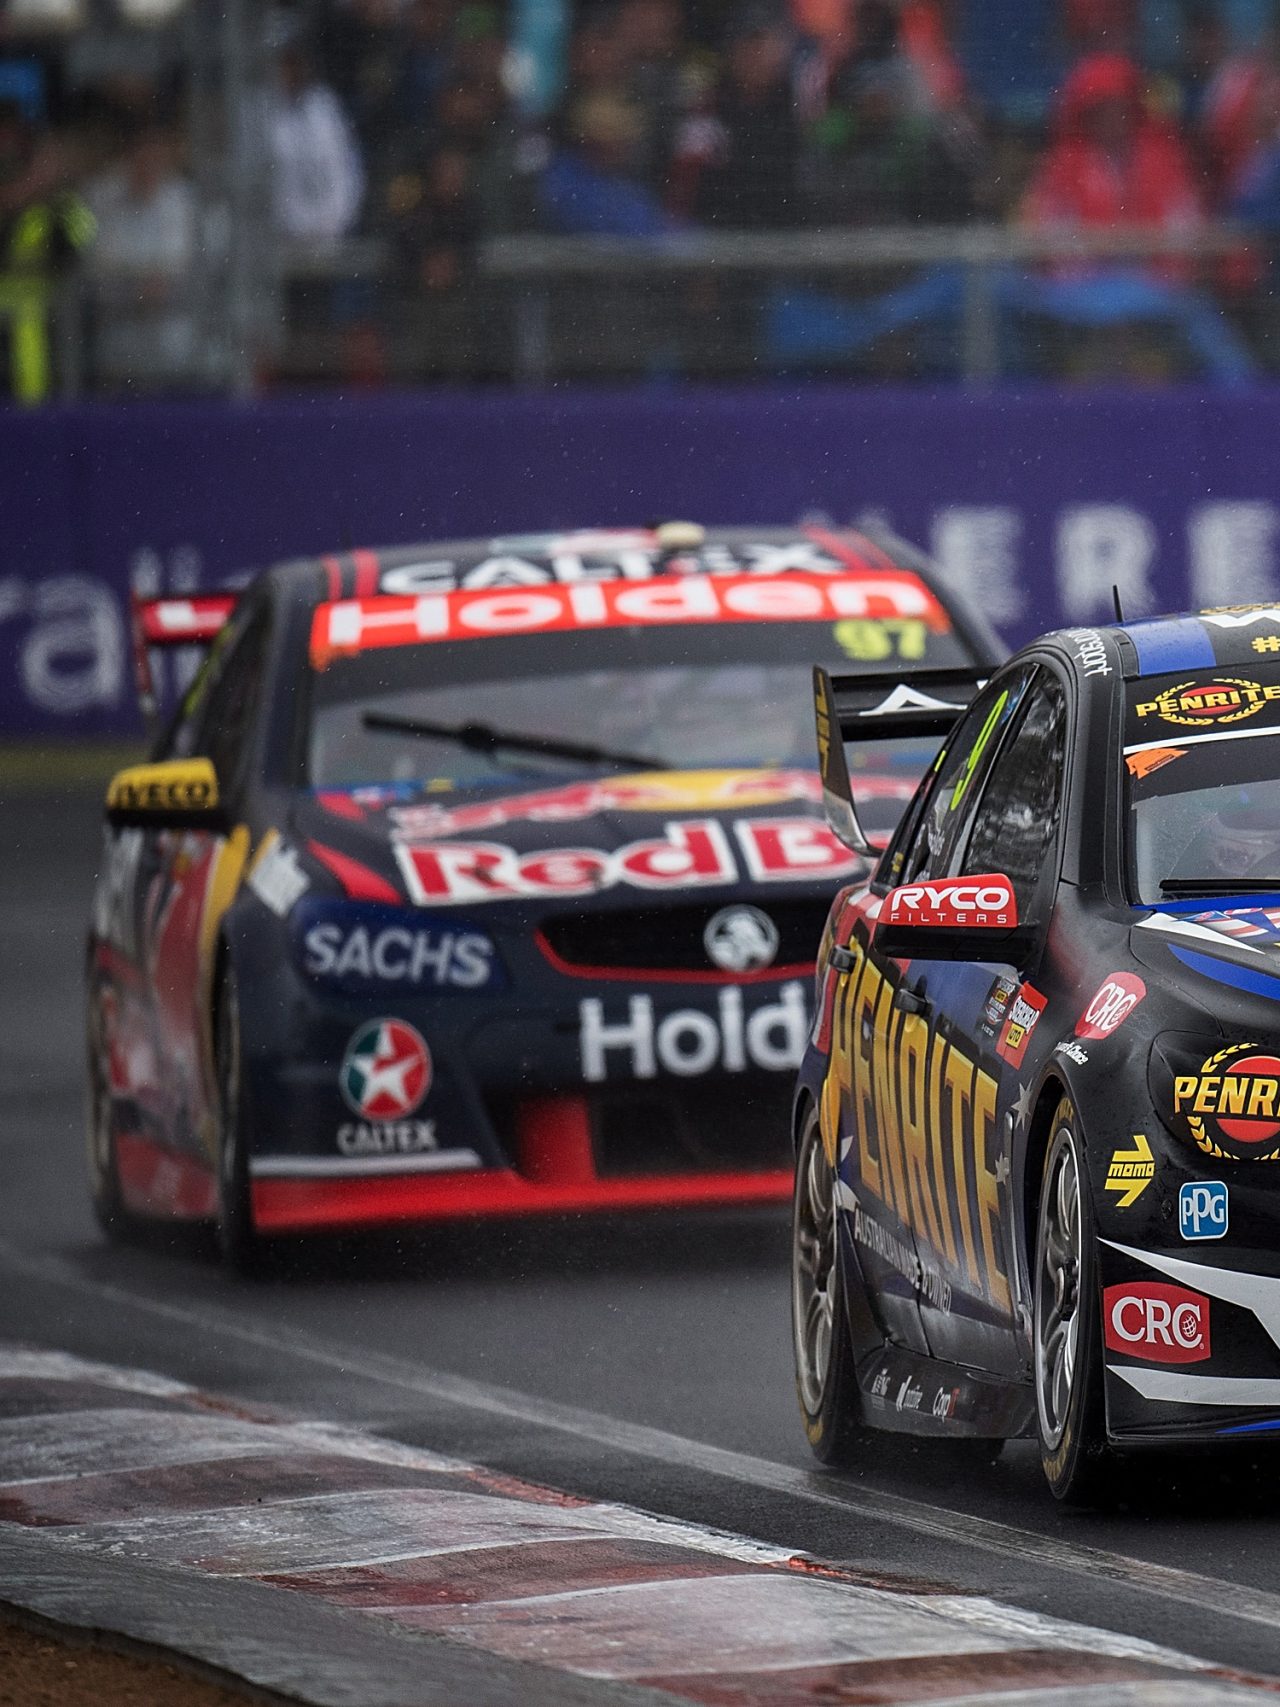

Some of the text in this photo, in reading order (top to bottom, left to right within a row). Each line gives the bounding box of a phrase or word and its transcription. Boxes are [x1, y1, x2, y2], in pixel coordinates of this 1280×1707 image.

[328, 574, 930, 644] Holden
[834, 619, 925, 661] 97
[397, 820, 736, 903] Red
[890, 912, 1007, 924] FILTERS
[891, 886, 1010, 911] RYCO
[305, 923, 496, 988] SACHS
[1085, 982, 1137, 1031] CRC
[336, 1120, 438, 1154] CALTEX
[1107, 1162, 1155, 1178] momo
[1182, 1188, 1225, 1232] PPG
[1111, 1296, 1203, 1349] CRC
